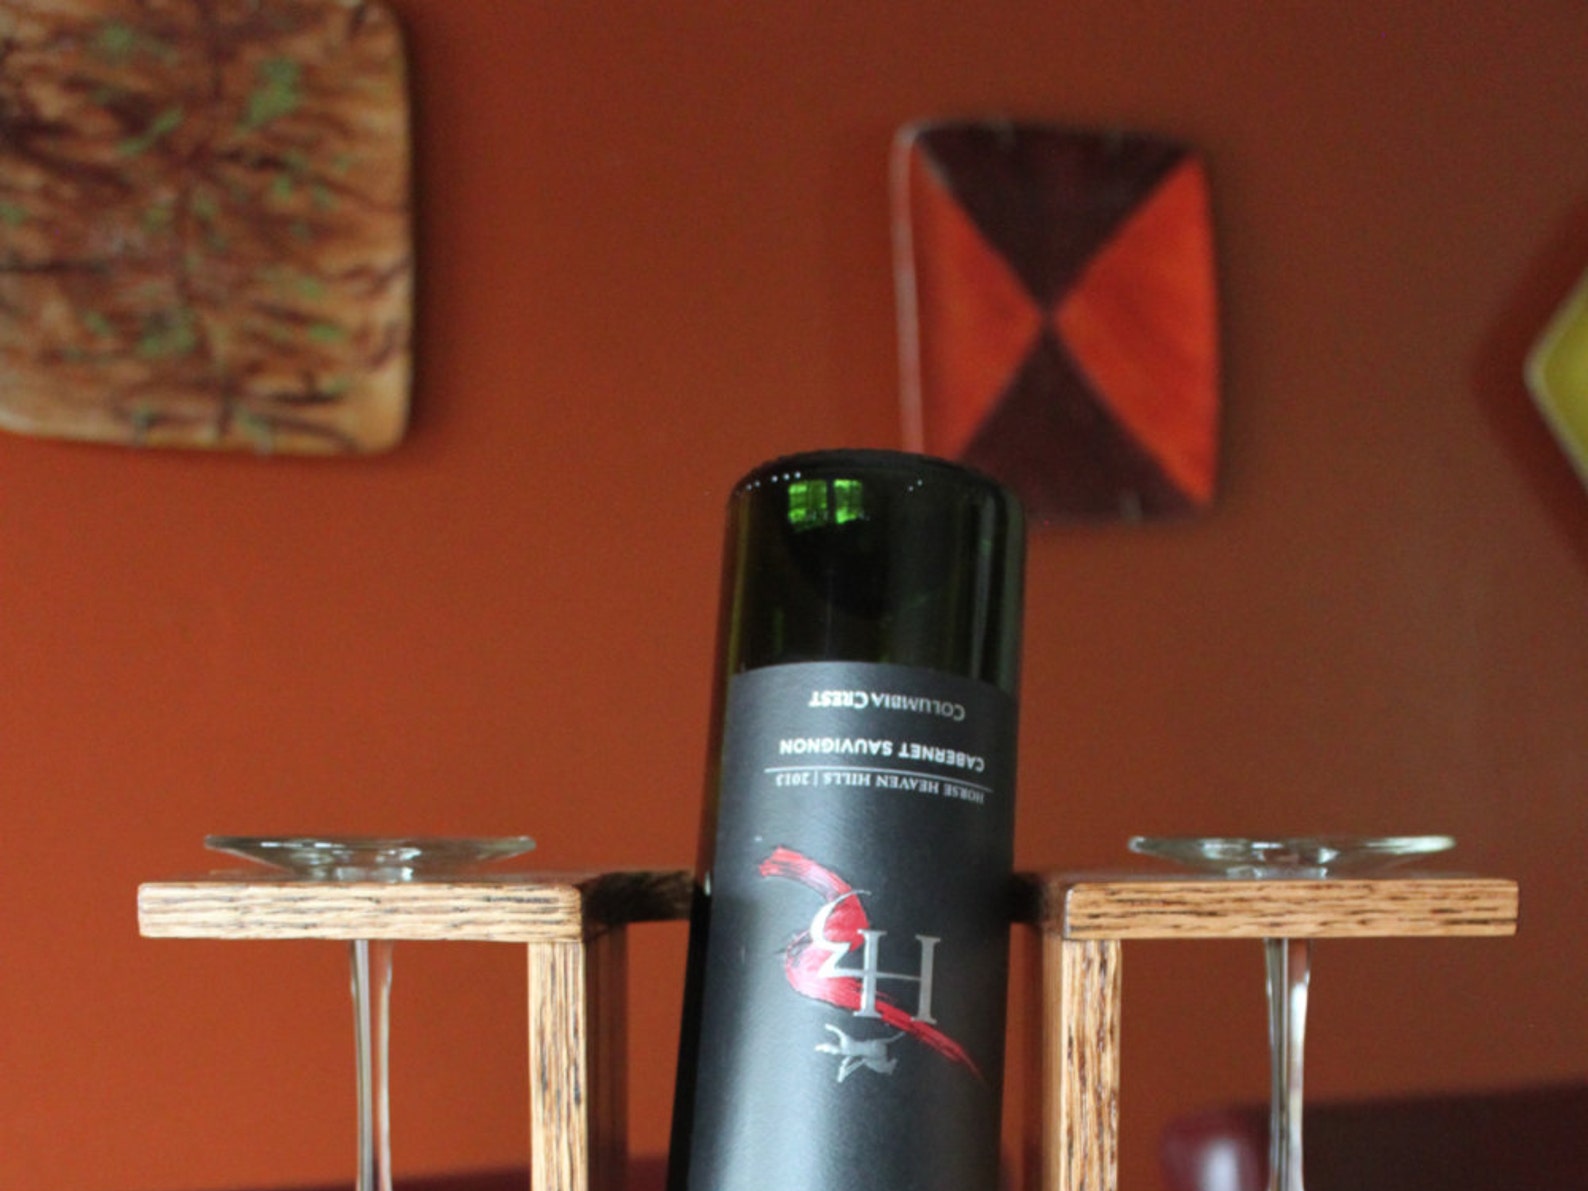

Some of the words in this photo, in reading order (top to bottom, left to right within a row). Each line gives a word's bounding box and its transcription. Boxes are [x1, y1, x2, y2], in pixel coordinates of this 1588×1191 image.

[808, 690, 869, 709] CREST
[871, 692, 966, 721] COLUMBIA
[779, 738, 893, 756] SAUVIGNON
[898, 743, 986, 772] CABERNET
[776, 772, 809, 787] 2013
[823, 773, 871, 787] HILLS
[876, 774, 939, 794] HEAVEN
[943, 783, 985, 804] HORSE
